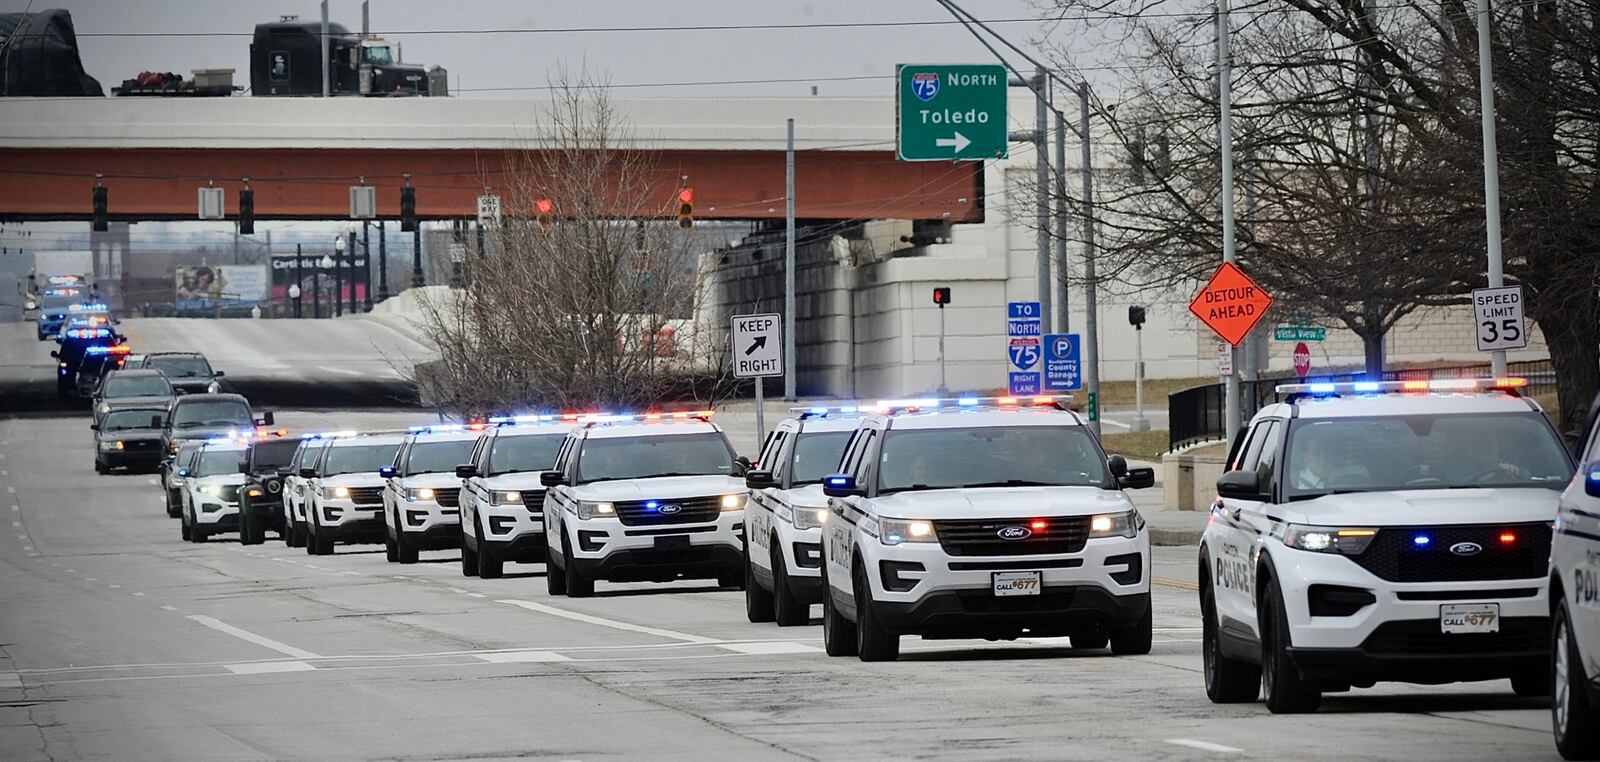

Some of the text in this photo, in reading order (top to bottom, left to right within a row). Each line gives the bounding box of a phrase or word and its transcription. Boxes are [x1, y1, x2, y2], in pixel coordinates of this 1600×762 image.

[915, 72, 997, 96] 75 NORTH
[920, 108, 989, 124] Toledo
[1205, 287, 1254, 304] DETOUR
[1477, 293, 1519, 306] SPEED
[1016, 305, 1033, 315] TO
[1209, 304, 1255, 320] AHEAD
[1483, 306, 1515, 318] LIMIT
[739, 319, 773, 333] KEEP
[1009, 323, 1040, 334] NORTH
[1481, 319, 1520, 343] 35
[1011, 346, 1037, 364] 75
[1294, 354, 1309, 367] STOP
[740, 358, 777, 373] RIGHT
[1048, 364, 1077, 373] County
[1014, 375, 1035, 383] RIGHT
[1048, 371, 1078, 380] Garage
[1014, 385, 1035, 393] LANE
[1216, 557, 1250, 593] POLICE
[1443, 618, 1465, 626] CALL
